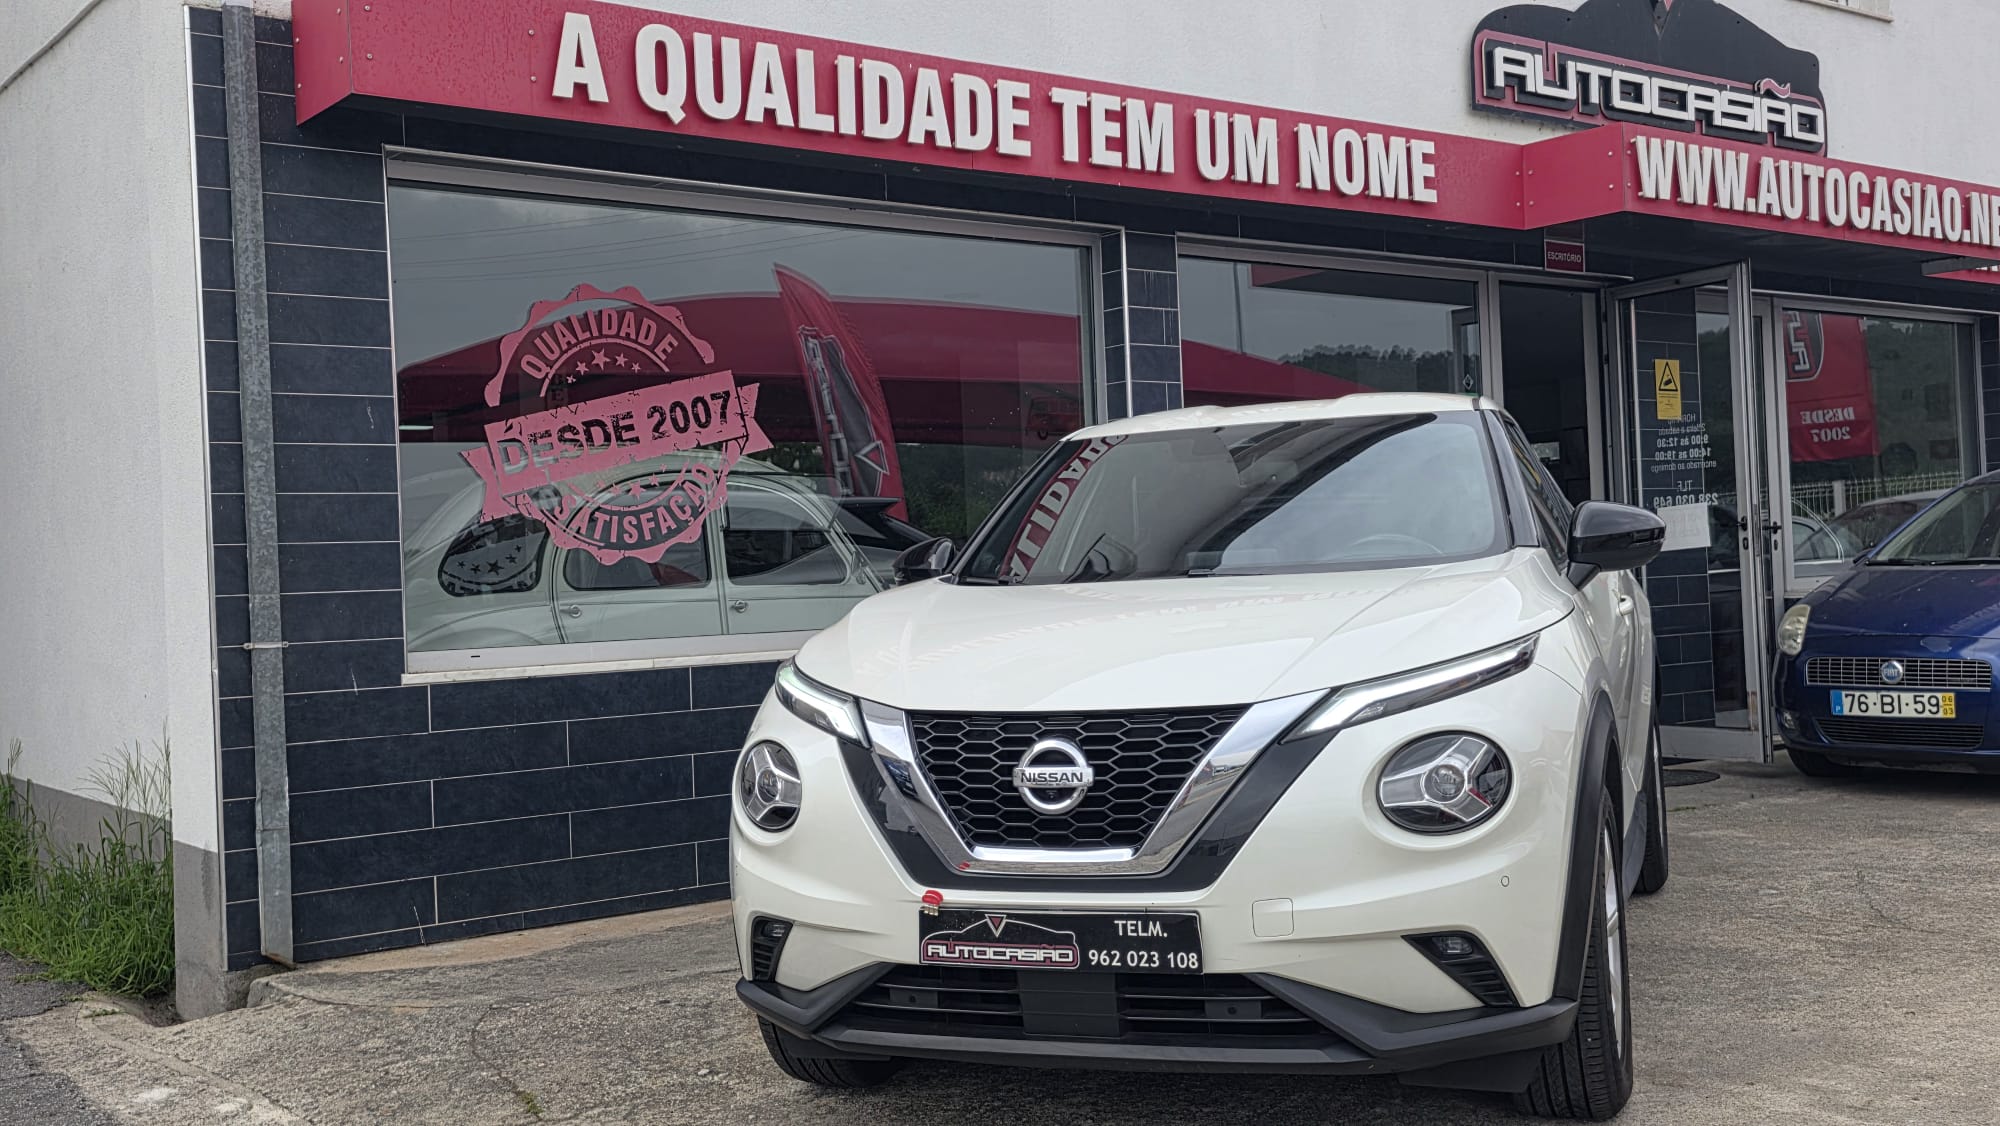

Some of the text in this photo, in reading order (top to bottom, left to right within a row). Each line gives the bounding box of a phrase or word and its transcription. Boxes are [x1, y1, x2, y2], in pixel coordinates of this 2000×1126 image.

[552, 11, 1438, 203] A QUALIDADE TEM UM NOME
[1493, 46, 1825, 144] AUTOCASIÃO
[1547, 251, 1582, 263] ESCRITÓRIO
[520, 308, 678, 379] QUALIDADE
[497, 390, 730, 475] DESDE 2007
[1020, 771, 1084, 784] NISSAN
[1114, 920, 1168, 937] TELM.
[1088, 949, 1199, 969] 962 023 108
